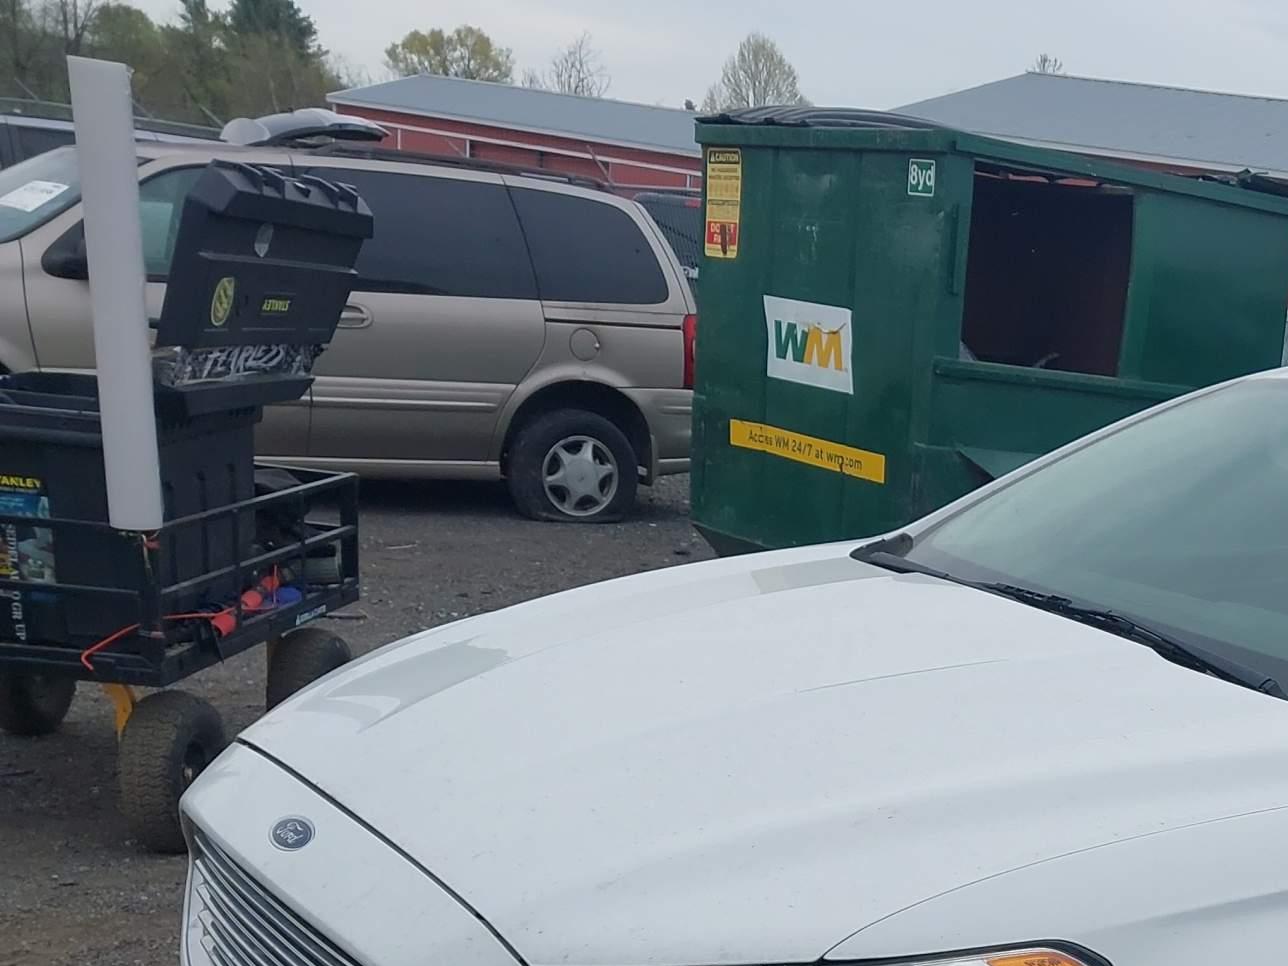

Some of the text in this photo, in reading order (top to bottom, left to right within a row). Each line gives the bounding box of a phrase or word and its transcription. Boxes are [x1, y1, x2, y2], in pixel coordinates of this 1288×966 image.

[910, 164, 934, 191] 8yd
[774, 319, 844, 372] WM
[774, 434, 790, 450] WM
[791, 439, 813, 456] 24/7
[815, 447, 823, 461] at
